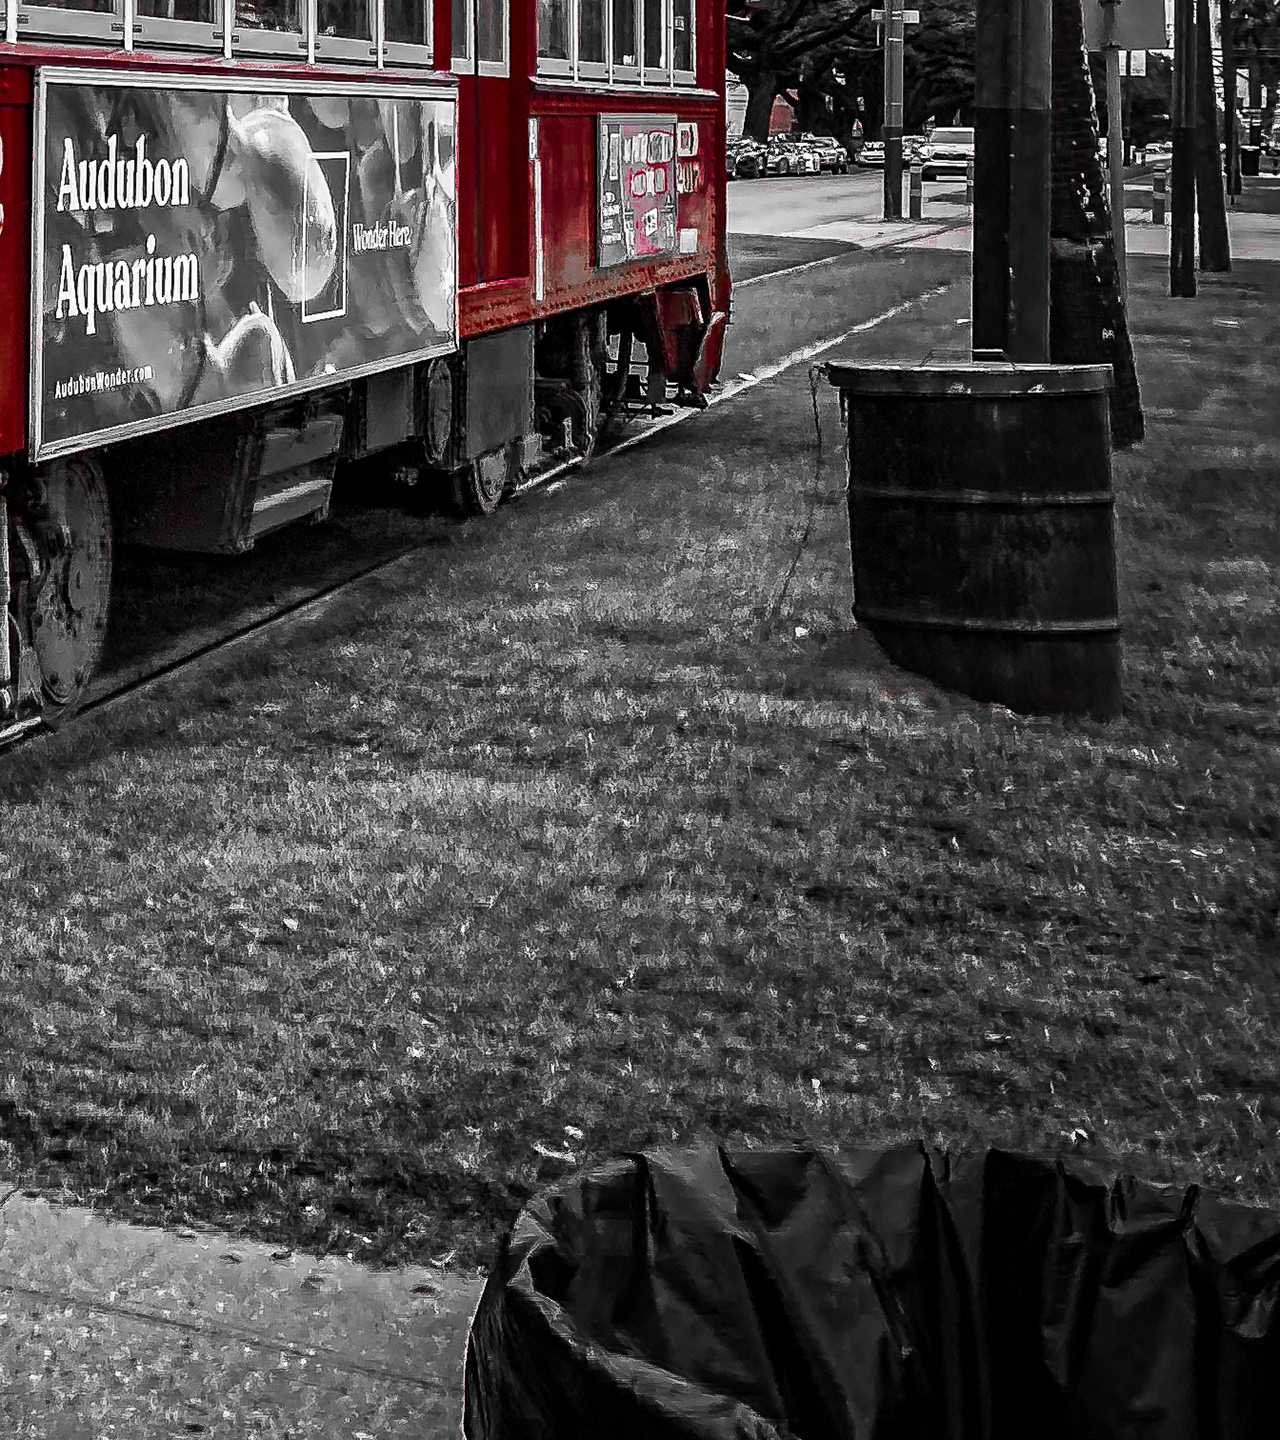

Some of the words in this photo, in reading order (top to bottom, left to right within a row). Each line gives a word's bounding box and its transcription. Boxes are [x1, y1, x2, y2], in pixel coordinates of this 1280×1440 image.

[56, 134, 190, 212] Audubon
[352, 221, 389, 252] Wonder
[389, 220, 412, 248] Here
[56, 234, 199, 335] Aquarium
[54, 364, 153, 400] AudubonWonder.com
